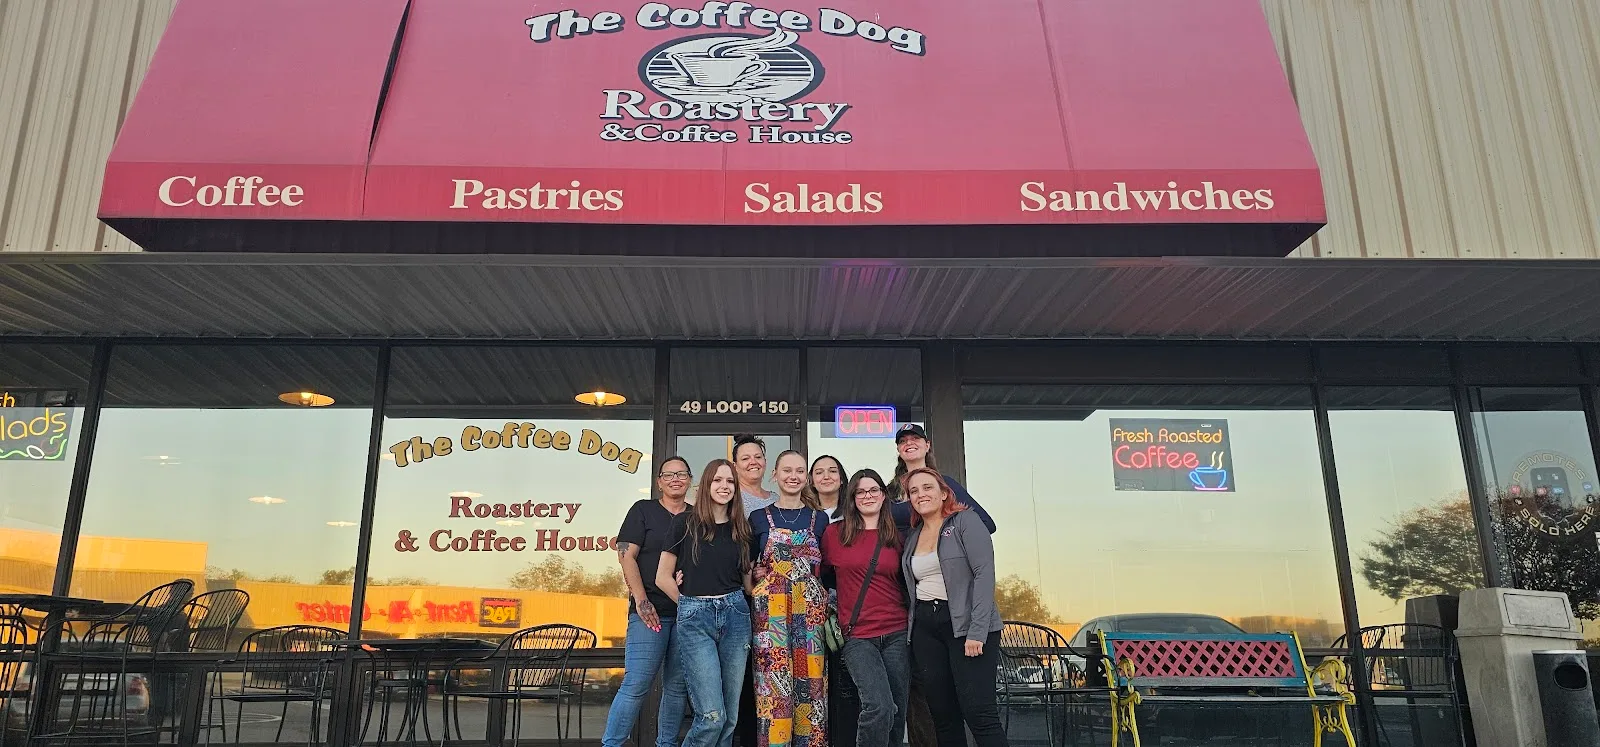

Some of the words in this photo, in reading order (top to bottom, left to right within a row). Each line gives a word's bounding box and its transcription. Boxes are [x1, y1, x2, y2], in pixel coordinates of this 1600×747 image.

[526, 10, 624, 43] The
[636, 1, 811, 33] Coffee
[820, 7, 926, 55] Dog
[600, 88, 852, 131] Roastery
[749, 125, 853, 144] House
[158, 175, 304, 206] Coffee
[449, 179, 624, 211] Pastries
[744, 182, 883, 213] Salads
[1020, 180, 1274, 211] Sandwiches
[0, 391, 15, 408] h
[680, 401, 701, 413] 49
[706, 401, 753, 413] LOOP
[758, 401, 789, 414] 150
[838, 409, 893, 434] OPEN
[1113, 428, 1153, 443] Fresh
[1159, 428, 1223, 443] Roasted
[390, 436, 453, 468] The
[461, 422, 571, 451] Coffee
[578, 429, 643, 474] Dog
[1115, 445, 1199, 469] Coffee
[1512, 453, 1586, 482] REMOTES
[449, 496, 582, 523] Roastery
[1521, 508, 1559, 536] SOLD
[1564, 506, 1594, 535] HERE
[394, 529, 419, 552] &
[429, 529, 526, 552] Coffee
